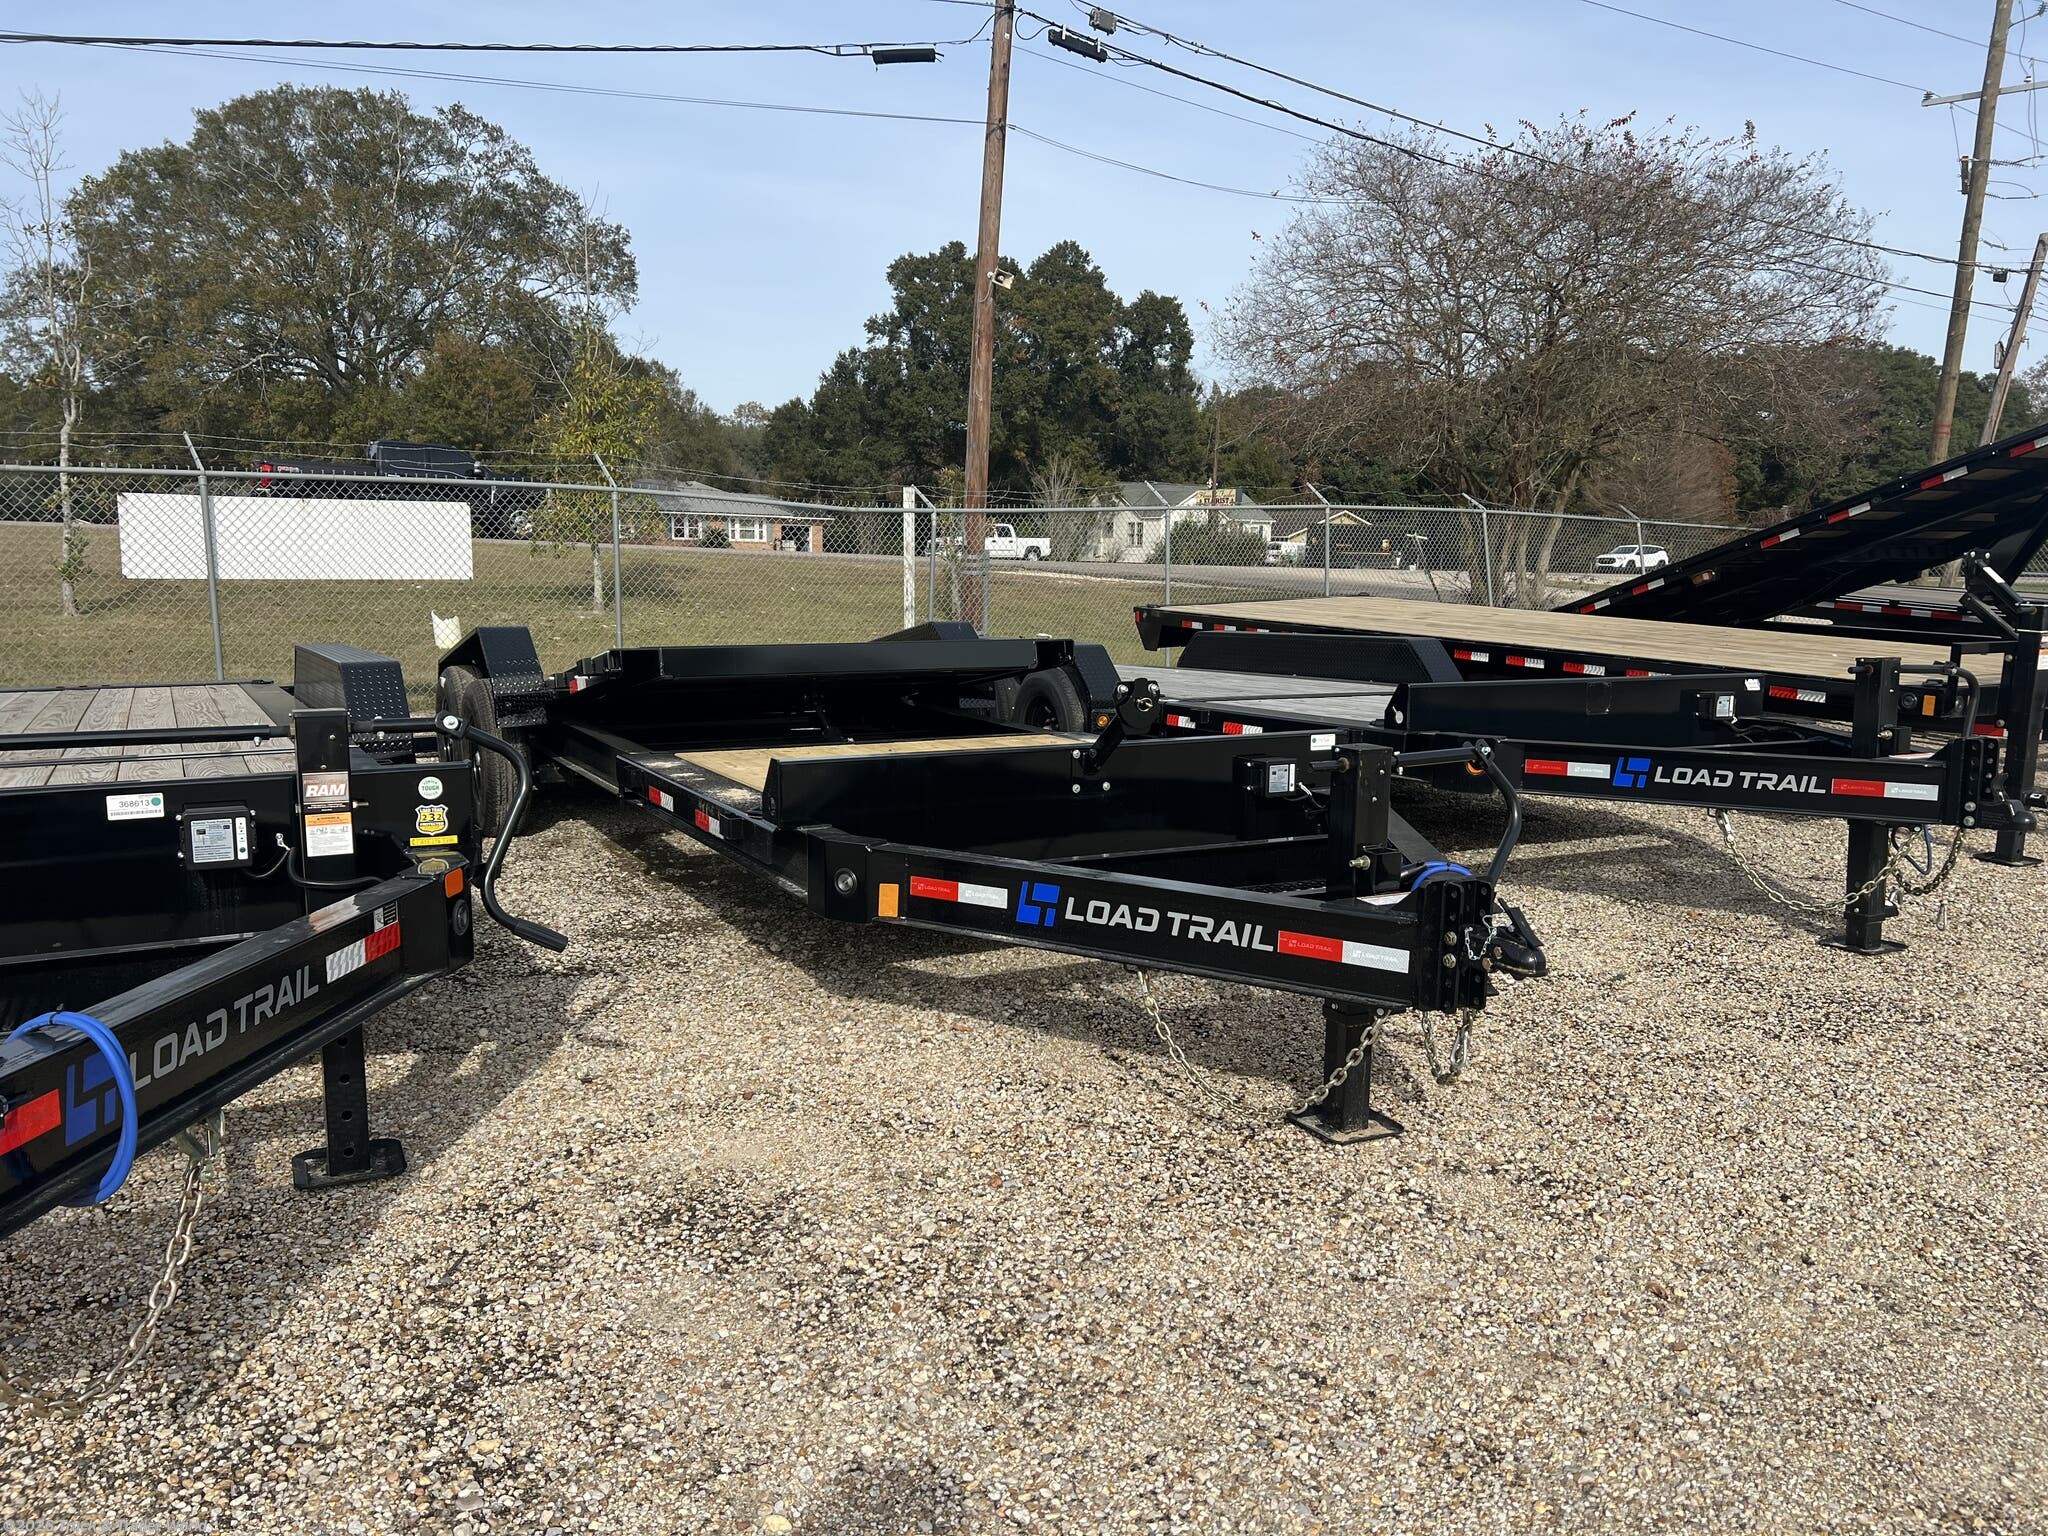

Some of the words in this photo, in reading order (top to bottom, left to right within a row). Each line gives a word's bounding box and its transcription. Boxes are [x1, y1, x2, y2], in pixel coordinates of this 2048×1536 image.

[305, 783, 346, 798] RAM
[1654, 766, 1733, 787] LOAD
[1739, 771, 1826, 794] TRAIL
[1065, 896, 1160, 932] LOAD
[1167, 911, 1274, 952] TRAIL
[129, 1008, 228, 1091] LOAD
[234, 965, 319, 1033] TRAIL
